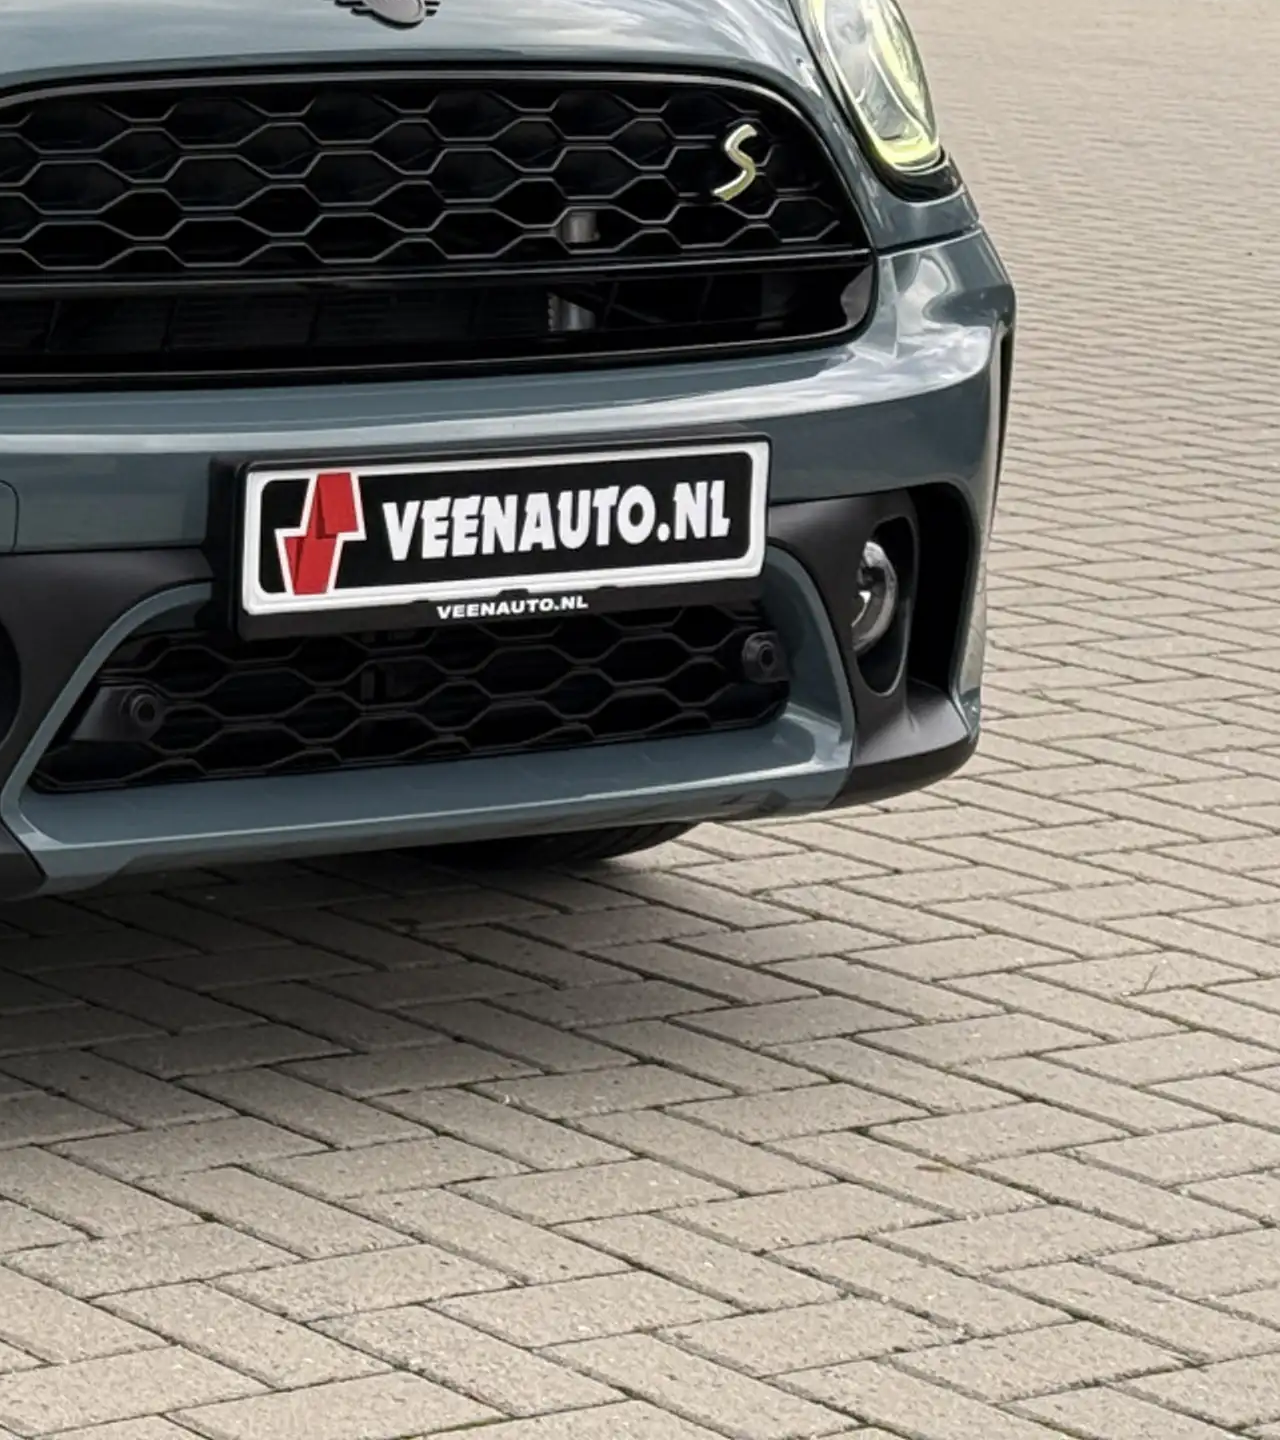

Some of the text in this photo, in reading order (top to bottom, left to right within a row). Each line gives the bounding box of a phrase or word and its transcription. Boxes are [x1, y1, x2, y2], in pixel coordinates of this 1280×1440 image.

[712, 124, 757, 202] S
[383, 480, 730, 561] VEENAUTO.NL
[436, 596, 589, 620] VEENAUTO.NL
